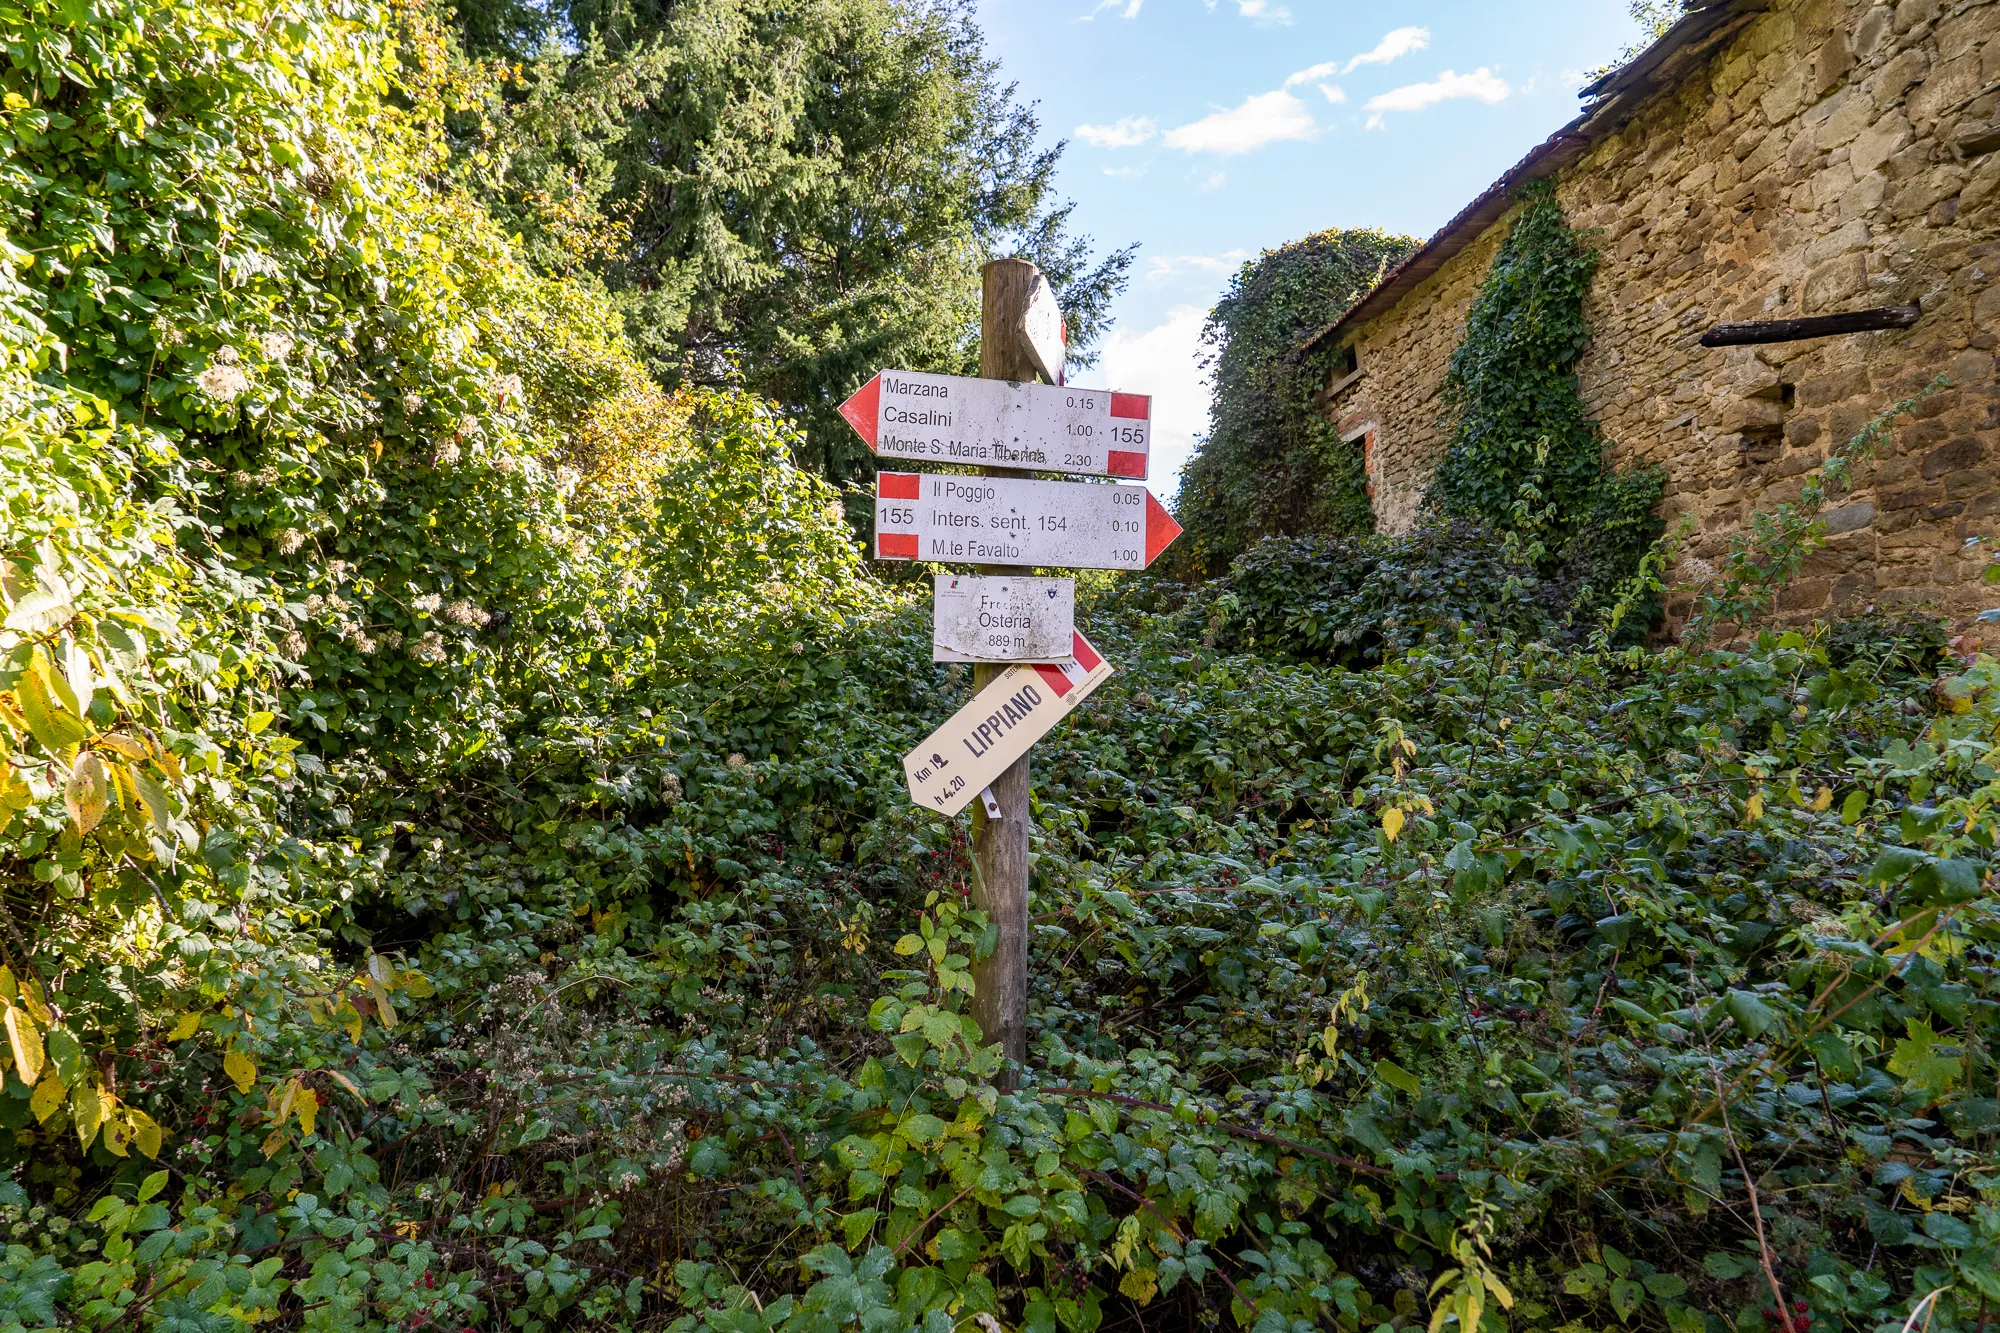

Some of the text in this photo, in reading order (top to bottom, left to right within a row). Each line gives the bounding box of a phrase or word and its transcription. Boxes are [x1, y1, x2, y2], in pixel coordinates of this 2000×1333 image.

[886, 378, 948, 398] Marzana
[1066, 396, 1094, 410] 0.15
[884, 406, 952, 427] Casalini
[1066, 424, 1093, 437] 1.00
[1110, 427, 1145, 444] 155
[883, 434, 925, 454] Monte
[931, 438, 944, 455] S.
[949, 441, 987, 458] Maria
[1064, 454, 1092, 467] 2.30
[933, 480, 996, 502] Il Poggio
[1112, 492, 1140, 506] 0.05
[880, 508, 914, 525] 155
[932, 510, 1067, 532] Inters. sent. 154
[1112, 520, 1139, 533] 0.10
[932, 539, 1019, 558] M.te Favalto
[1112, 549, 1138, 562] 1.00
[979, 612, 1031, 629] Osteria
[988, 635, 1025, 647] 889 m
[962, 685, 1042, 758] LIPPIANO
[913, 766, 932, 783] Km
[933, 794, 944, 806] h
